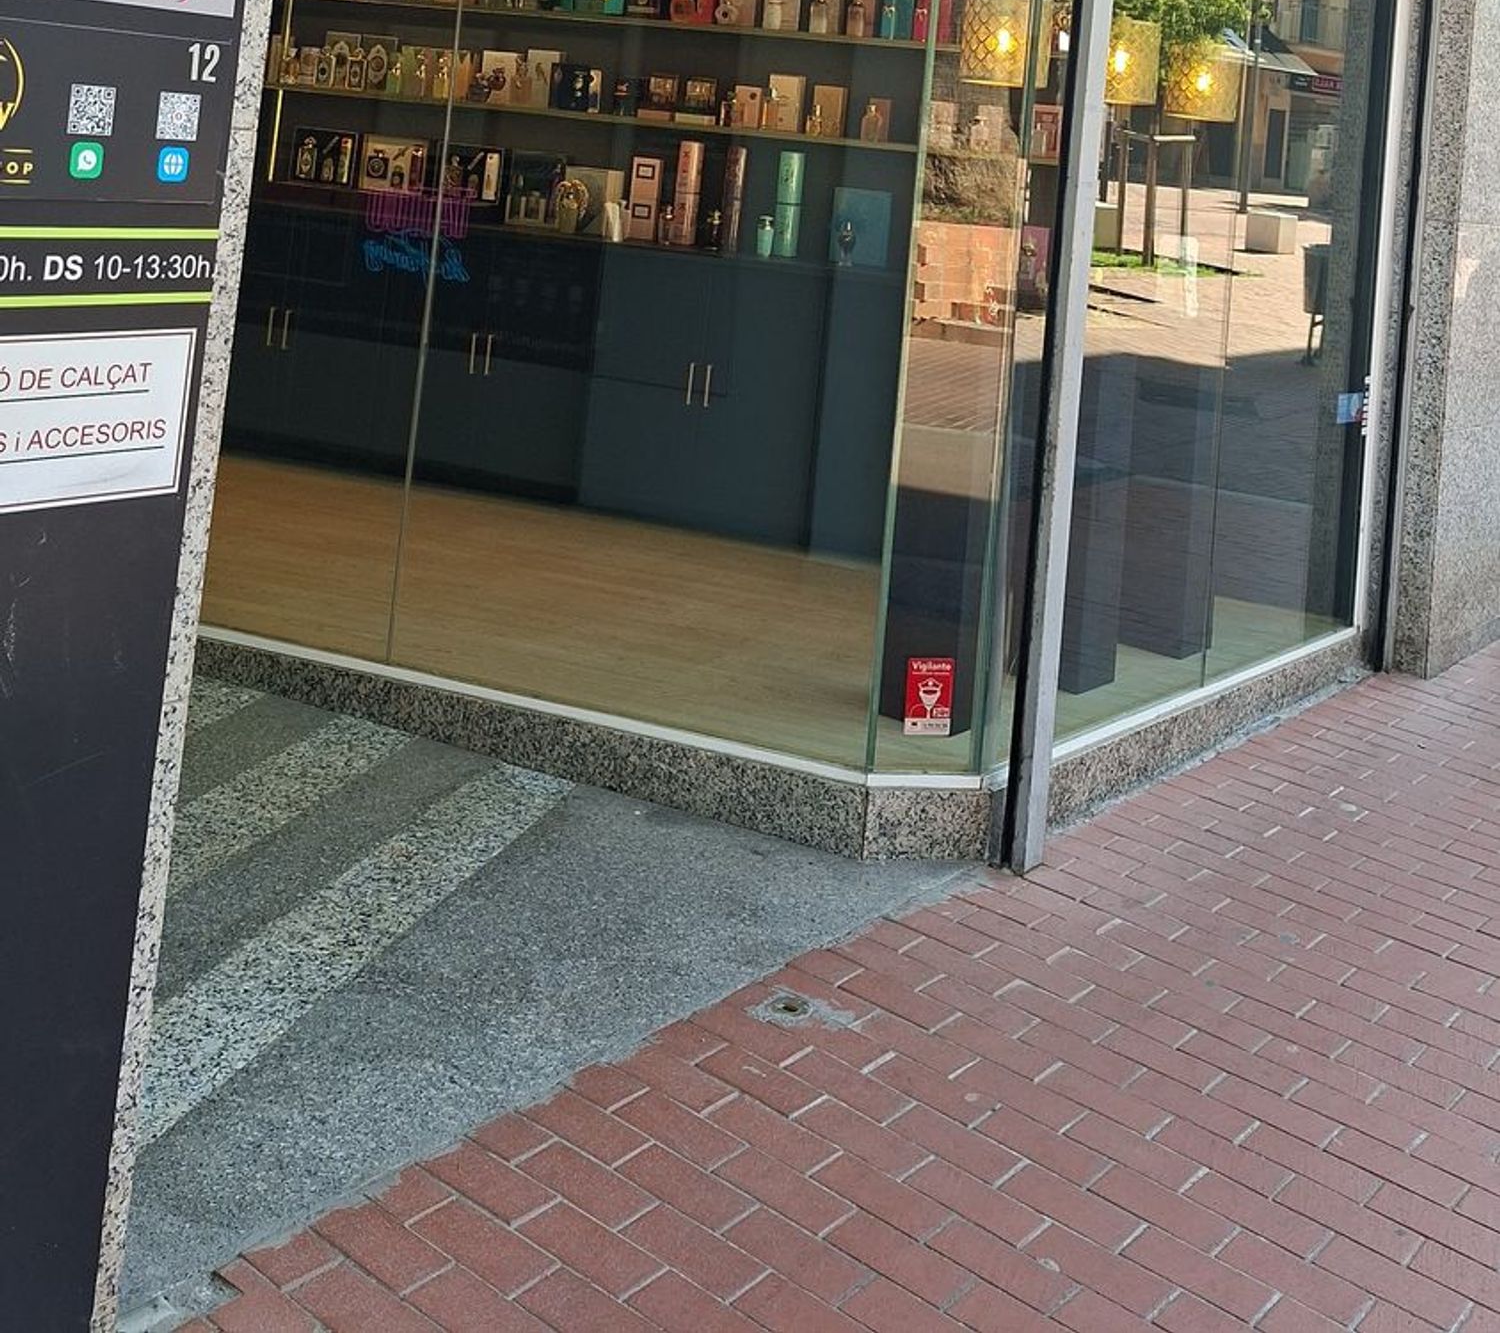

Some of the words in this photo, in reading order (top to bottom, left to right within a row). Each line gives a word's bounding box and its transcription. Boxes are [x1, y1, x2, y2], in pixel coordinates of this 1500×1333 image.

[188, 43, 220, 83] 12
[43, 254, 83, 281] DS
[19, 368, 53, 391] DE
[60, 363, 152, 389] CALÇAT
[15, 431, 20, 452] i
[26, 419, 167, 451] ACCESORIS
[911, 660, 952, 672] Vigilante
